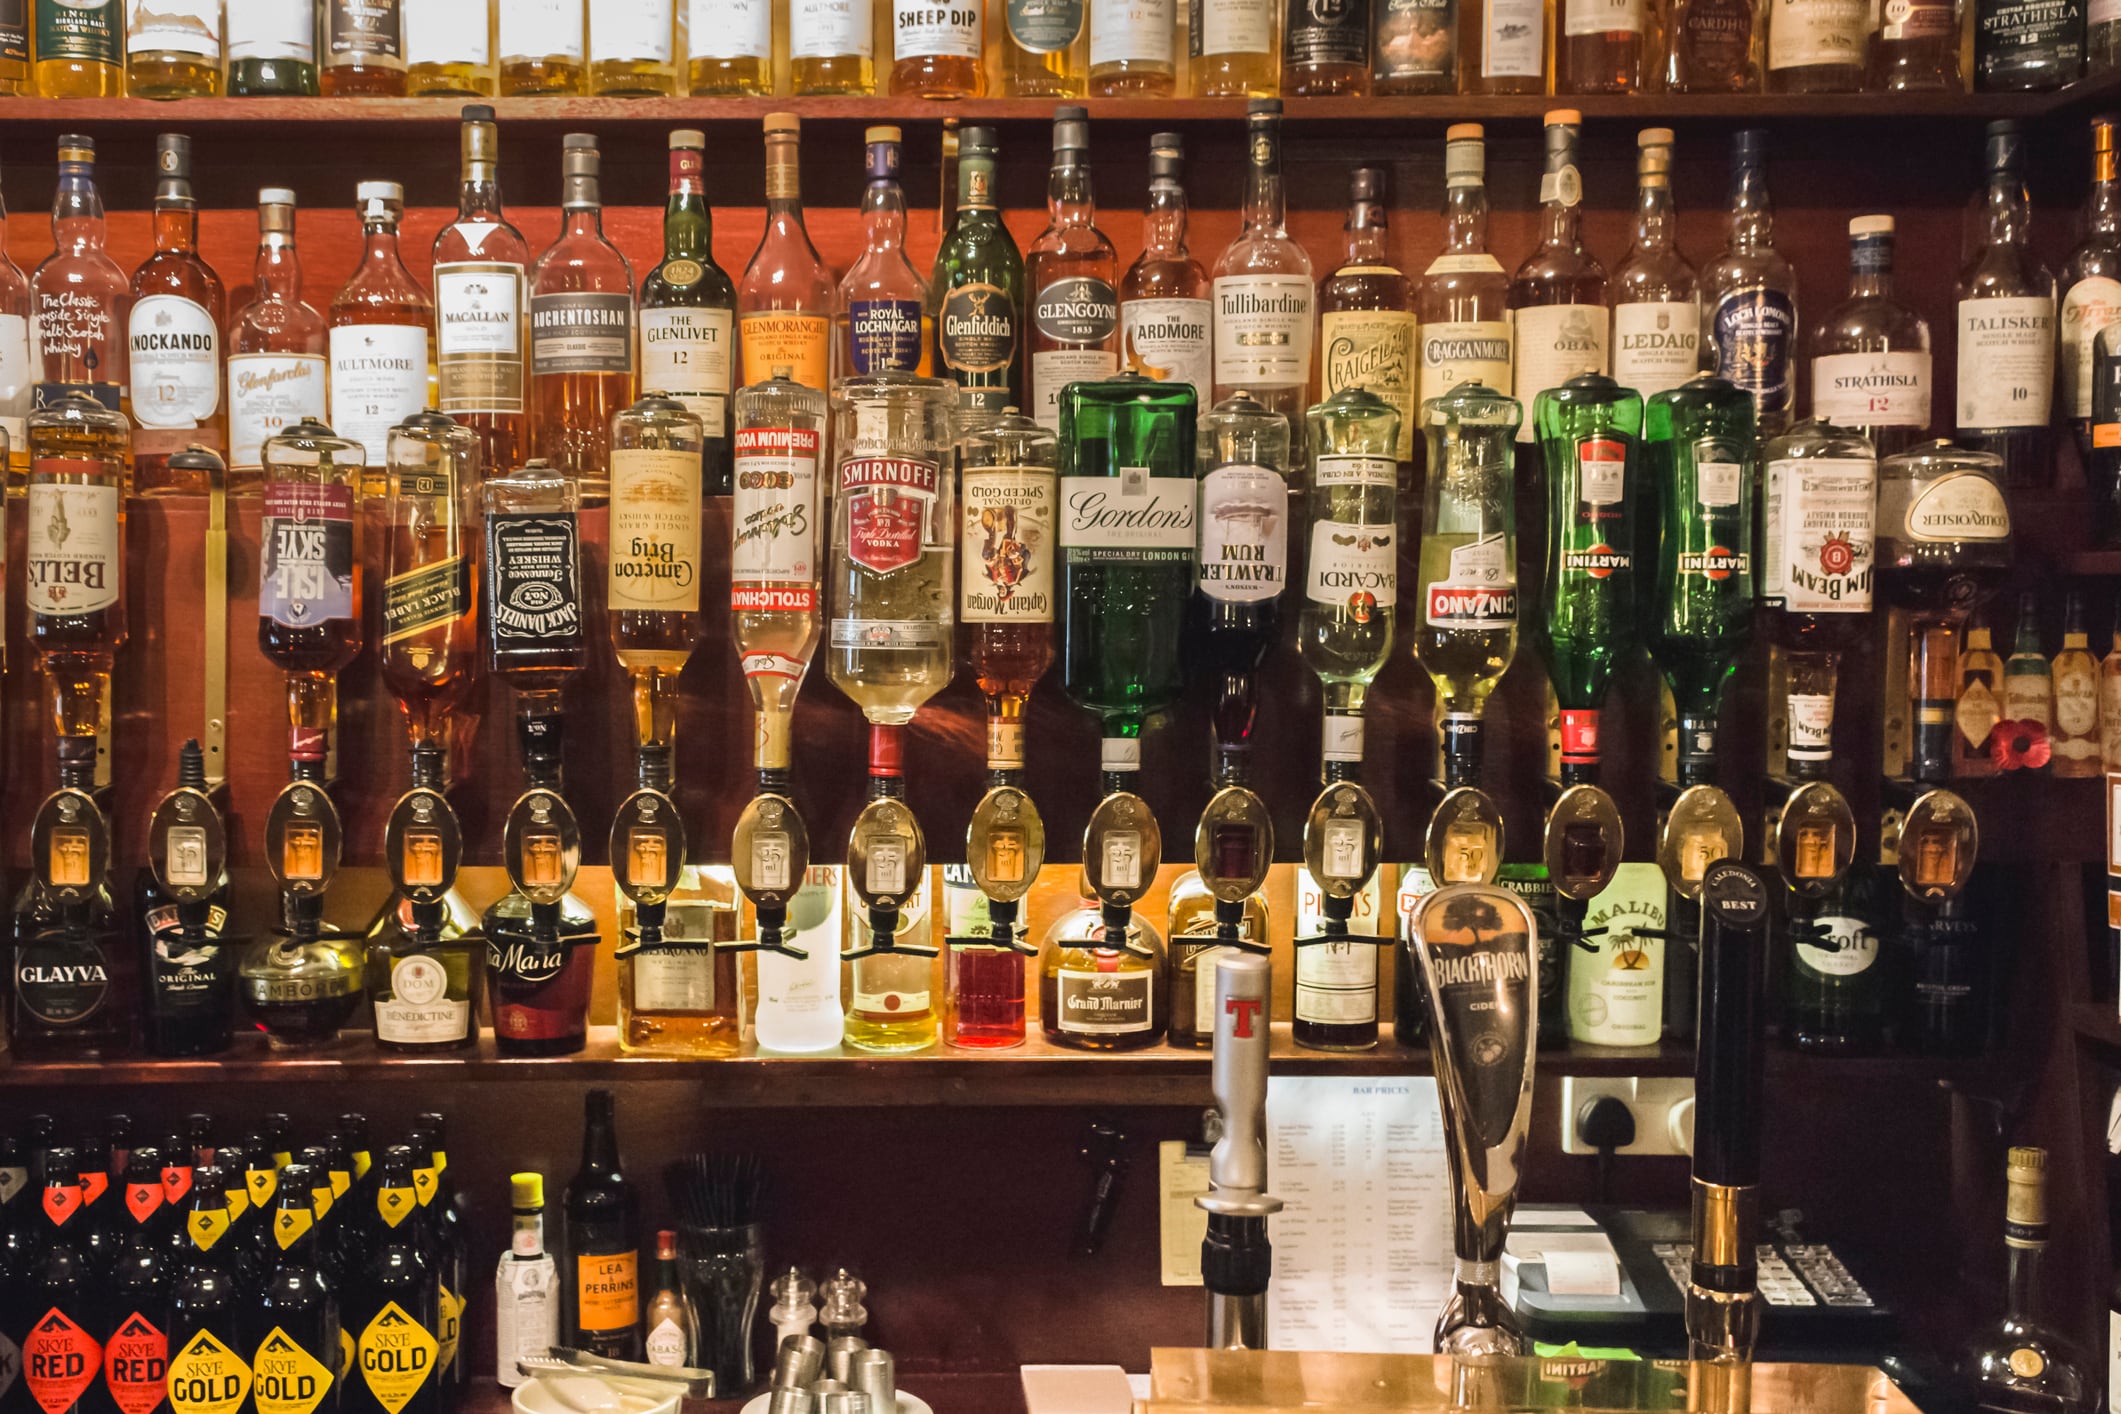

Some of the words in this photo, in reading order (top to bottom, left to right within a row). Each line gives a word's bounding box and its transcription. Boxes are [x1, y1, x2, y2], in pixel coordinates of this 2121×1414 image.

[899, 10, 944, 28] SHEEP
[952, 10, 976, 27] DIP
[1984, 6, 2078, 30] STRATHISLA
[40, 294, 58, 308] The
[59, 291, 99, 308] Classic
[1221, 293, 1306, 316] Tullibardine
[75, 309, 110, 328] Single
[446, 311, 511, 323] MACALLAN
[534, 310, 625, 327] AUCHENTOSHAN
[670, 316, 691, 326] THE
[870, 309, 904, 320] ROYAL
[1167, 315, 1180, 323] THE
[1725, 308, 1754, 328] LOCH
[744, 320, 825, 334] GLENMORANGIE
[855, 320, 918, 334] LOCHNAGAR
[947, 315, 1010, 336] Glenfiddich
[1071, 326, 1092, 335] 1833
[1138, 324, 1204, 340] ARDMORE
[1968, 318, 2048, 331] TALISKER
[648, 327, 718, 343] GLENLIVET
[1622, 334, 1695, 350] LEDAIG
[1425, 338, 1509, 367] CRAGGANMORE
[1554, 340, 1599, 351] OBAN
[672, 351, 688, 364] 12
[760, 352, 806, 361] ORIGINAL
[337, 358, 413, 372] AULTMORE
[237, 361, 313, 397] Glenfarclas
[1442, 370, 1453, 381] 12
[1834, 375, 1917, 389] STRATHISLA
[157, 384, 177, 402] 12
[971, 393, 985, 406] 12
[2013, 387, 2027, 400] 10
[365, 405, 379, 415] 12
[1868, 398, 1889, 412] 12
[264, 416, 282, 428] 10
[757, 432, 815, 449] PREMIUM
[843, 462, 934, 486] SMIRNOFF
[420, 481, 431, 490] 12
[971, 487, 1001, 498] GOLD
[1003, 486, 1044, 498] SPICED
[655, 513, 690, 521] SCOTCH
[1069, 490, 1193, 531] Gordon's
[618, 522, 648, 530] GRAIN
[1803, 520, 1836, 529] STRAIGHT
[1923, 511, 2007, 527] COURVOISIER
[853, 527, 876, 544] Triple
[877, 526, 916, 541] Distilled
[277, 531, 325, 560] SKYE
[867, 540, 900, 548] VODKA
[509, 555, 562, 564] WHISKEY
[1093, 550, 1124, 558] SPECIAL
[1143, 551, 1180, 561] LONDON
[1221, 544, 1265, 561] RUM
[1833, 551, 1841, 561] B
[1567, 555, 1630, 567] MARTINI
[1685, 556, 1745, 568] MARTINI
[28, 560, 105, 590] BELL'S
[508, 570, 563, 581] Tennessee
[615, 561, 693, 587] Cameron
[1200, 564, 1282, 582] TRAWLER
[1320, 571, 1395, 589] BACARDI
[1846, 564, 1873, 594] JIM
[277, 566, 324, 600] ISLE
[1791, 563, 1841, 600] BEAM
[422, 586, 461, 607] BLACK
[967, 593, 1009, 615] Morgan
[1009, 591, 1047, 615] Captain
[384, 601, 420, 620] LABEL
[1435, 593, 1516, 617] CINZANO
[494, 604, 546, 634] DANIEL'S
[547, 602, 577, 628] JACK
[1798, 721, 1821, 738] BEAM
[761, 850, 780, 863] 25
[1112, 850, 1133, 862] 25
[1459, 847, 1484, 861] 50
[1699, 845, 1725, 860] 50
[877, 856, 896, 869] 25
[1711, 870, 1758, 889] CALEDONIA
[1722, 900, 1757, 911] BEST
[1591, 900, 1665, 928] MALIBU
[20, 965, 108, 984] GLAYVA
[158, 972, 216, 983] ORIGINAL
[1435, 951, 1529, 989] BLACKTHORN
[1067, 995, 1099, 1010] Grand
[1101, 995, 1143, 1010] Marnier
[1226, 996, 1261, 1038] T
[1353, 1086, 1372, 1095] BAR
[1374, 1086, 1410, 1095] PRICES
[599, 1264, 623, 1276] LEA
[585, 1278, 634, 1295] PERRINS
[37, 1338, 74, 1354] SKYE
[375, 1333, 411, 1348] SKYE
[119, 1343, 156, 1358] SKYE
[32, 1353, 84, 1378] RED
[263, 1359, 296, 1375] SKYE
[364, 1347, 427, 1372] GOLD
[113, 1358, 165, 1382] RED
[186, 1361, 223, 1378] SKYE
[174, 1375, 241, 1402] GOLD
[256, 1375, 315, 1401] GOLD
